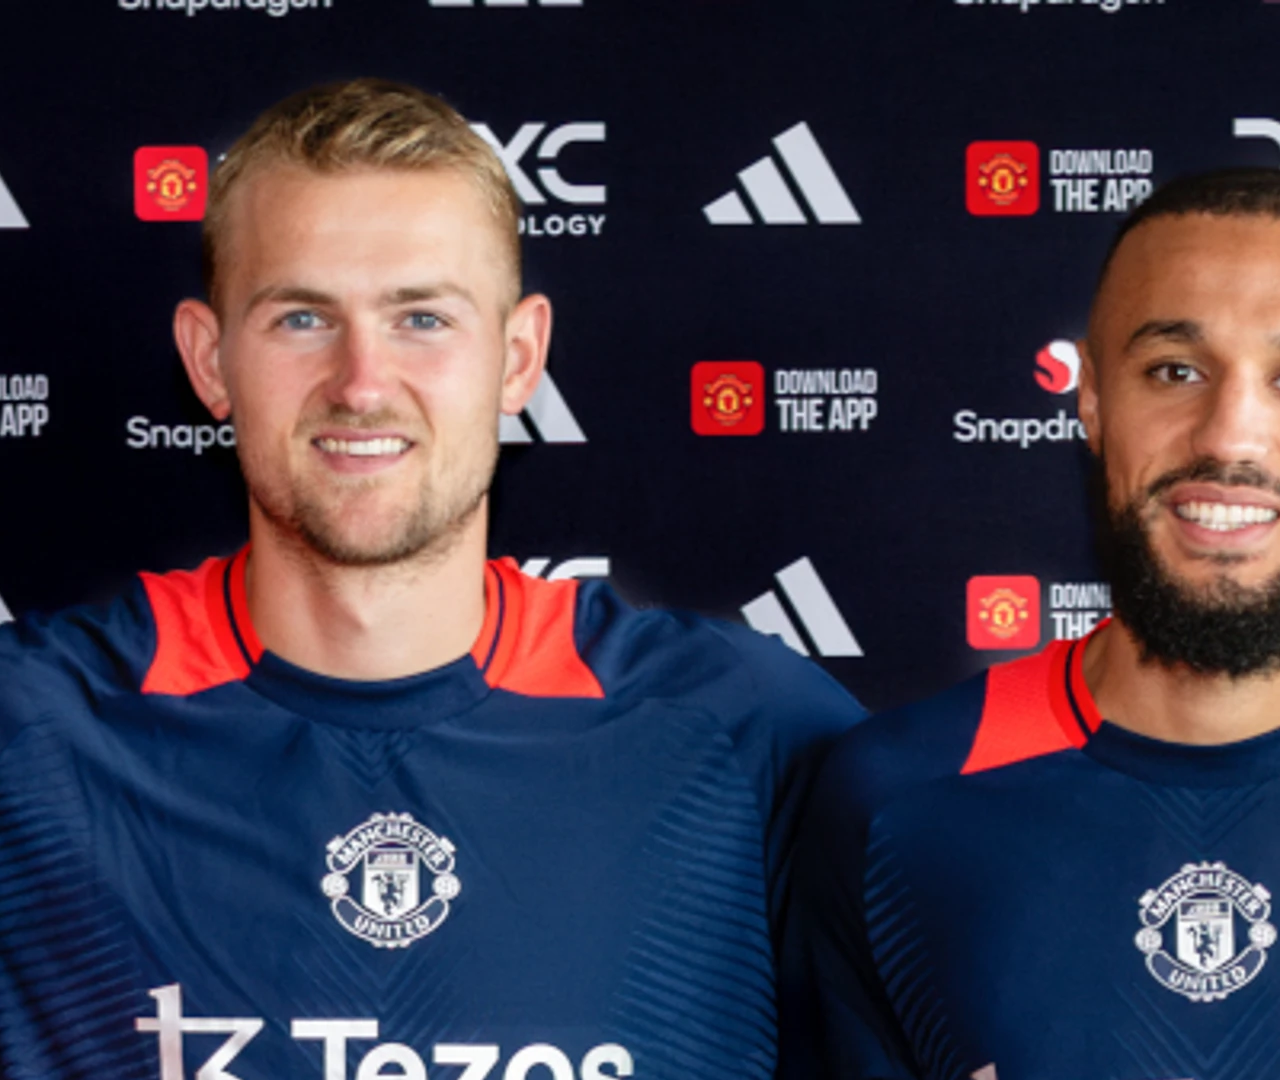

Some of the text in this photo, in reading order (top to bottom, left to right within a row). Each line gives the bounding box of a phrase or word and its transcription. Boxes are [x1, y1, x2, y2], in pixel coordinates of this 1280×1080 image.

[482, 123, 605, 210] XC
[1050, 150, 1152, 175] DOWNLOAD
[1051, 177, 1153, 213] THE APP
[776, 369, 877, 394] DOWNLOAD
[0, 404, 48, 436] APP
[776, 397, 877, 430] THE APP
[954, 410, 1087, 449] Snapdr
[354, 914, 430, 937] UNITED
[1169, 964, 1246, 993] UNITED
